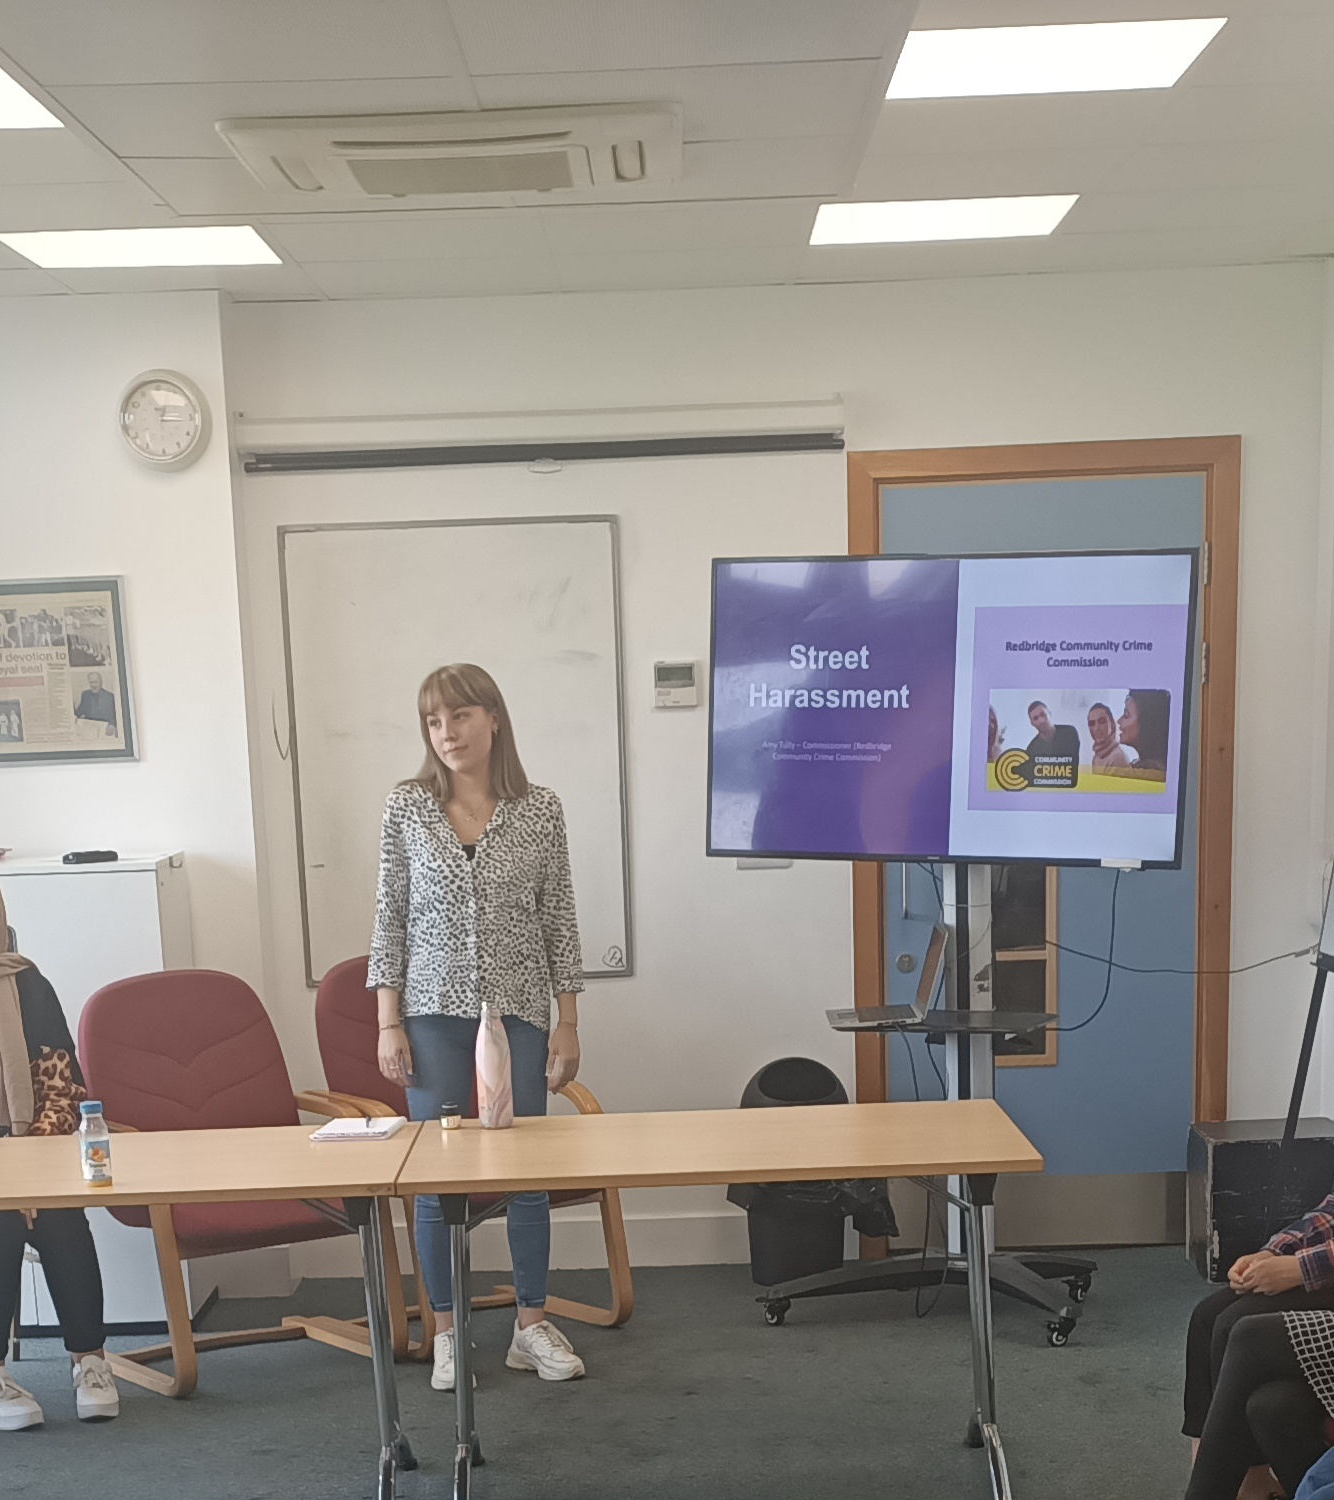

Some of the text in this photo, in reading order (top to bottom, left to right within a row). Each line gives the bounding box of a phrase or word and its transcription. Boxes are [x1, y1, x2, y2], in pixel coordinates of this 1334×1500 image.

[1005, 640, 1153, 653] Redbridge Community Crime
[5, 652, 53, 663] devotion
[55, 651, 67, 660] to
[789, 644, 870, 670] Street
[1046, 657, 1109, 668] Commission
[20, 664, 43, 674] seal
[749, 683, 910, 709] Harassment
[761, 741, 778, 751] Amy
[772, 752, 812, 762] Community
[813, 752, 834, 761] Crime
[1033, 764, 1073, 777] CRIME
